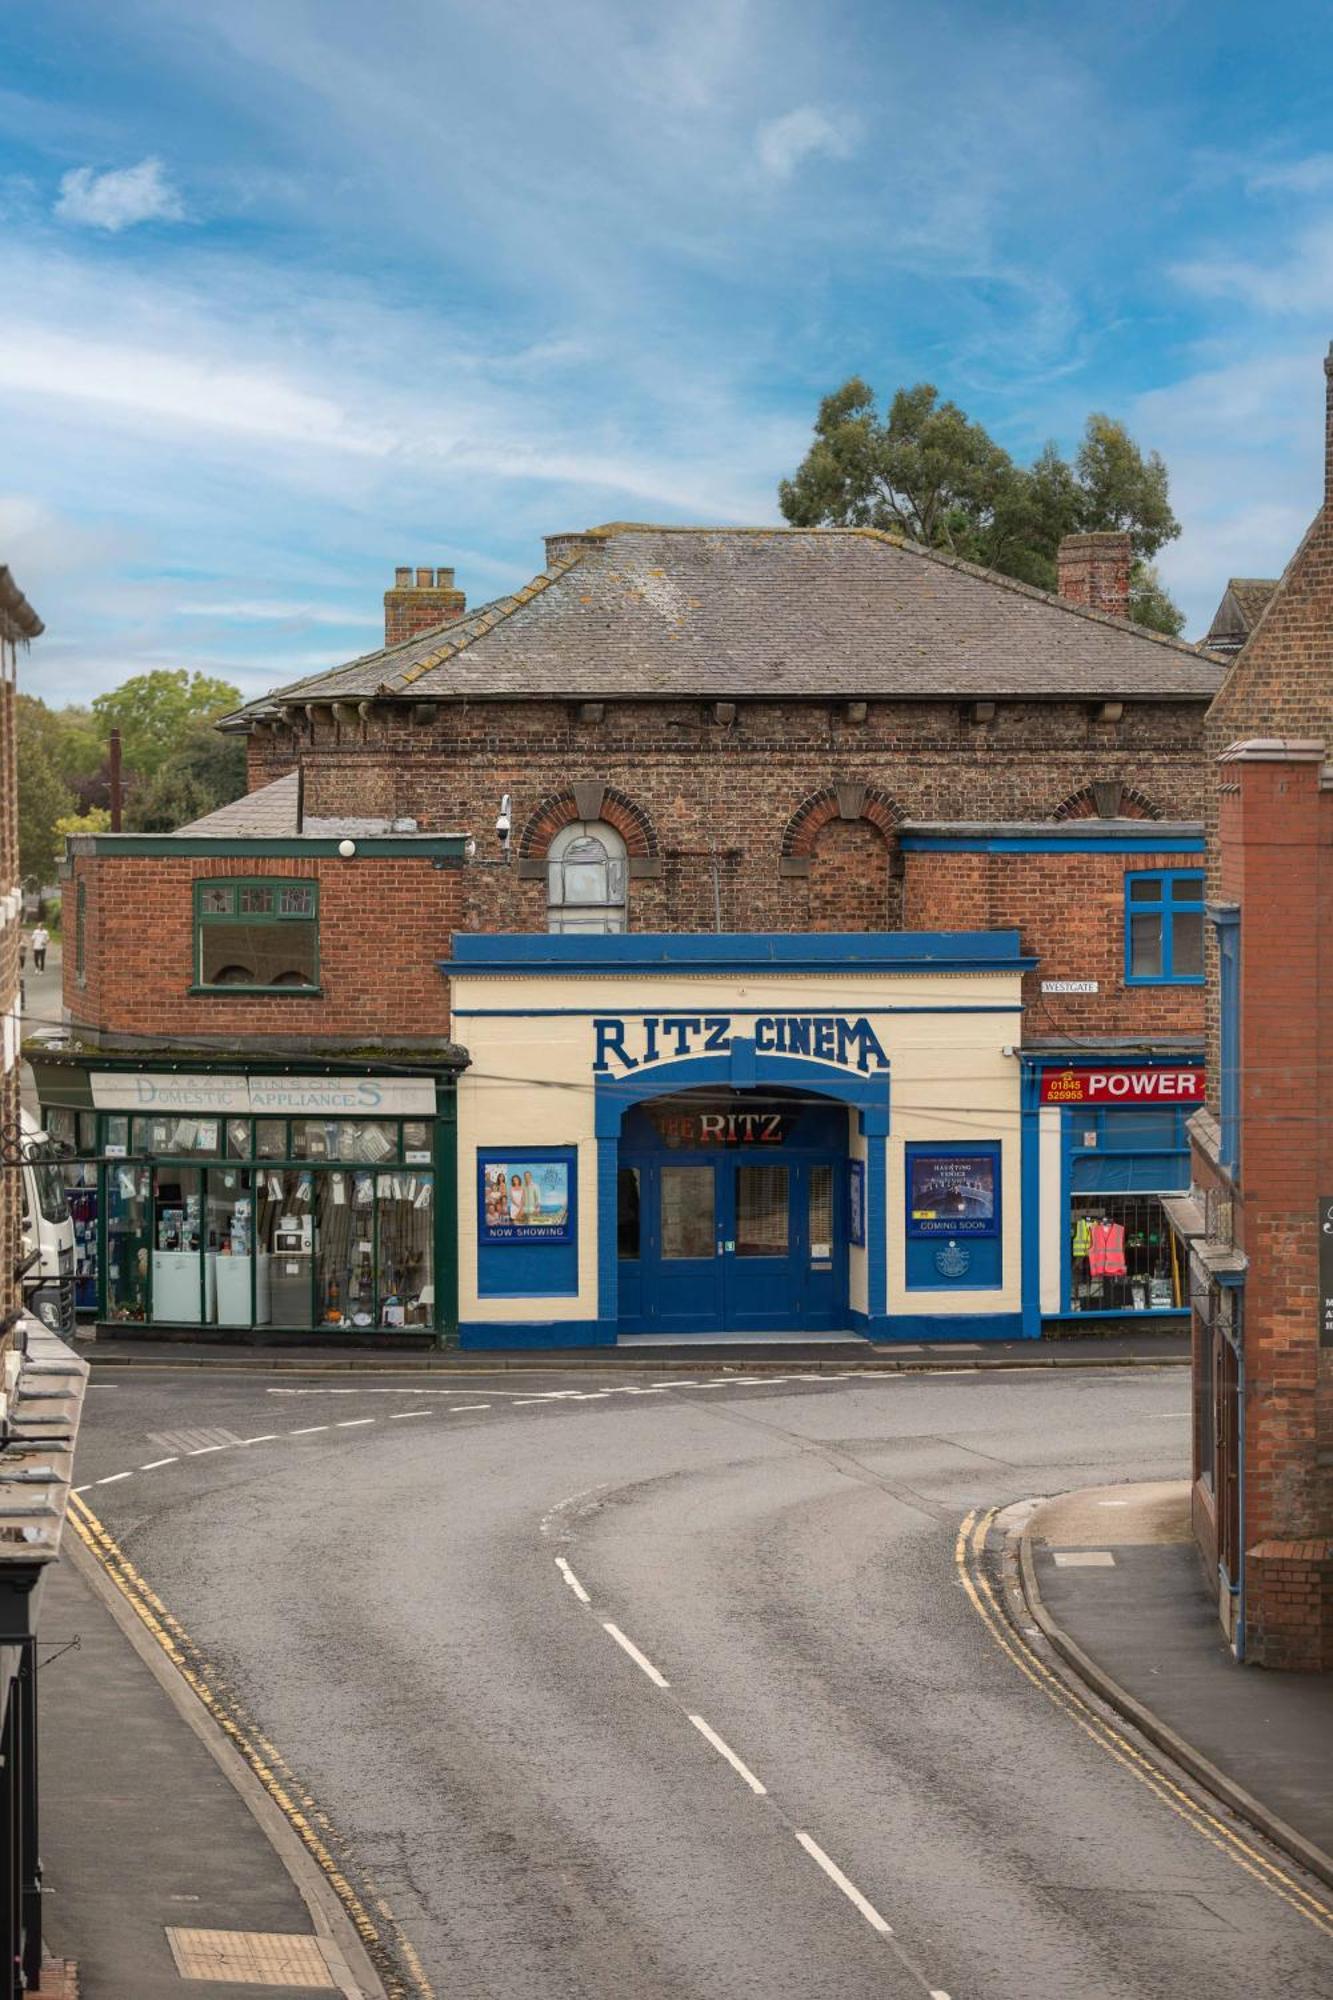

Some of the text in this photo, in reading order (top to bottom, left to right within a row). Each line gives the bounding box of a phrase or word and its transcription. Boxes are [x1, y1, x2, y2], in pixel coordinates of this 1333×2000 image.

[1044, 982, 1094, 992] WESTGATE
[593, 1017, 891, 1073] RITZ CINEMA
[1051, 1080, 1081, 1090] 01845
[1088, 1074, 1196, 1096] POWER
[700, 1114, 782, 1141] RITZ
[920, 1221, 986, 1230] COMING SOON
[489, 1227, 564, 1237] NOW SHOWING
